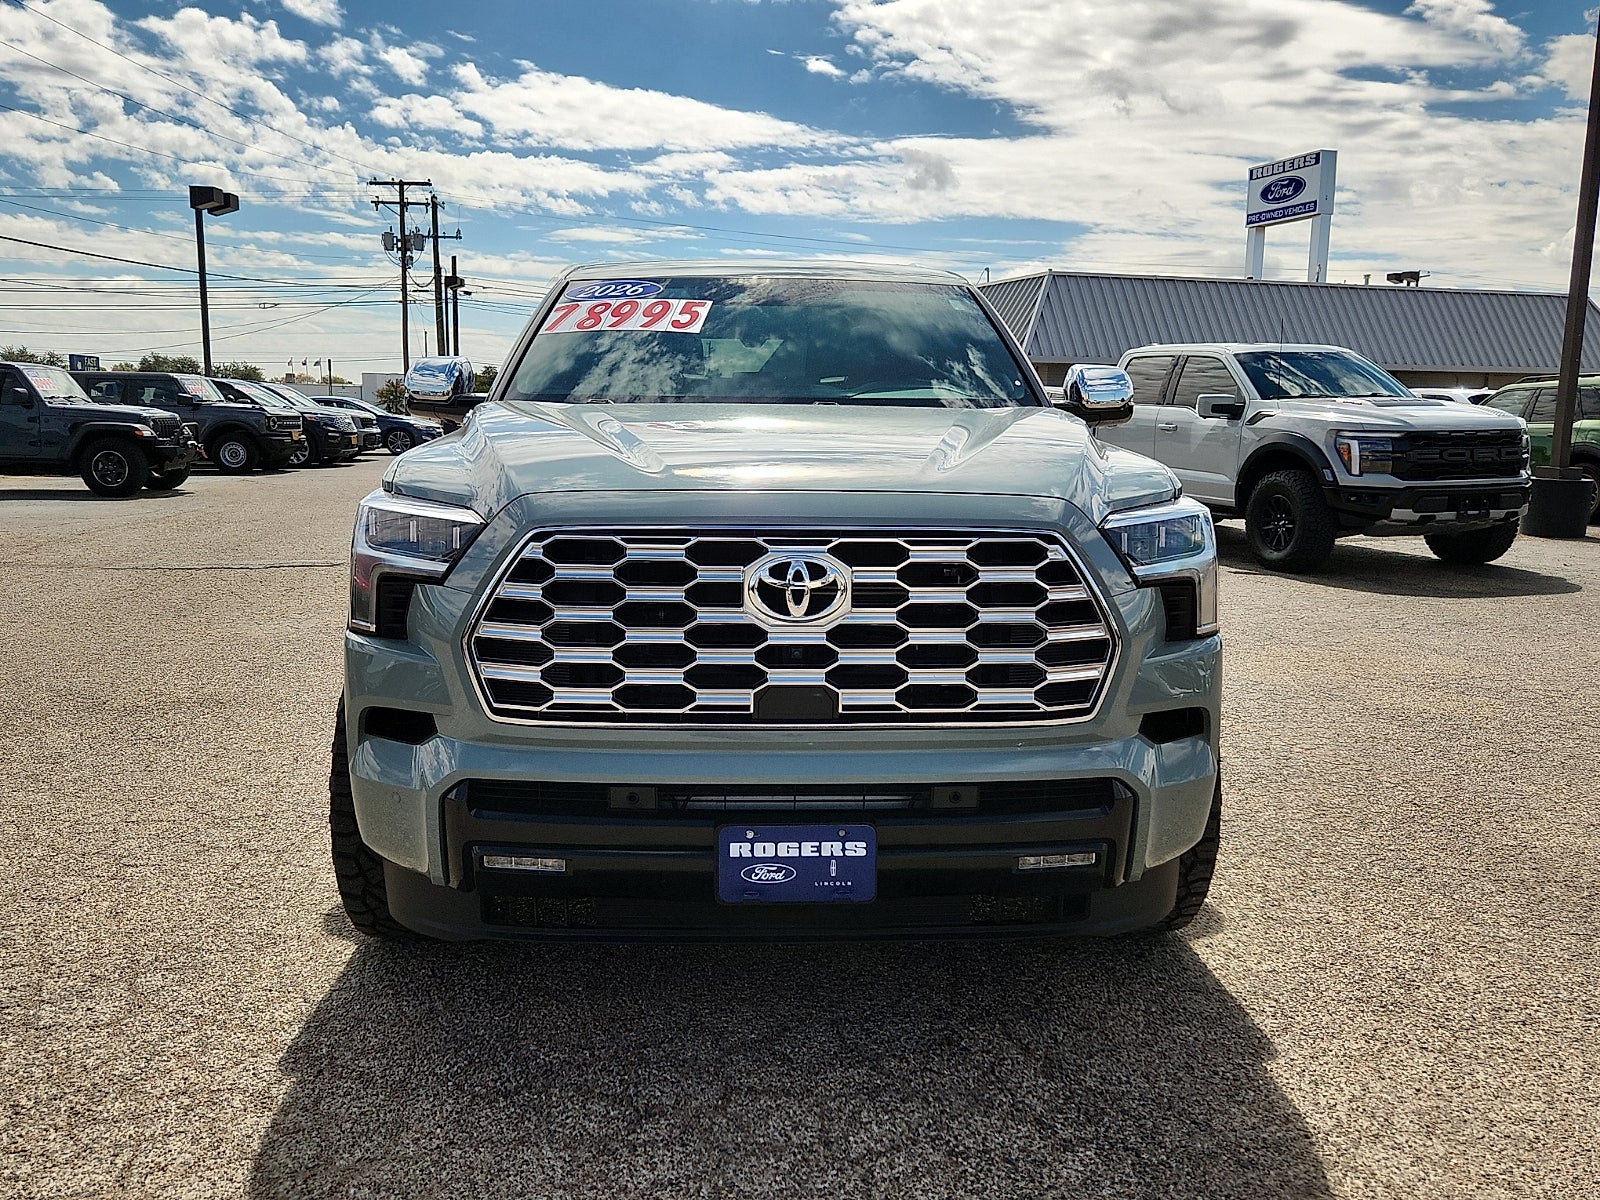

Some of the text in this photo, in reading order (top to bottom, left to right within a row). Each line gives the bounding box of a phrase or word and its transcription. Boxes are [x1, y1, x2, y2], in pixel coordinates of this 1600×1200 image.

[1252, 154, 1316, 179] ROGERS
[1268, 180, 1295, 199] Ford
[1248, 203, 1314, 222] PRE-OWNED VEHICLES
[579, 284, 644, 298] 2026
[545, 300, 706, 332] 78995
[1406, 449, 1521, 462] FORD
[729, 842, 867, 858] ROGERS
[751, 866, 786, 881] Ford
